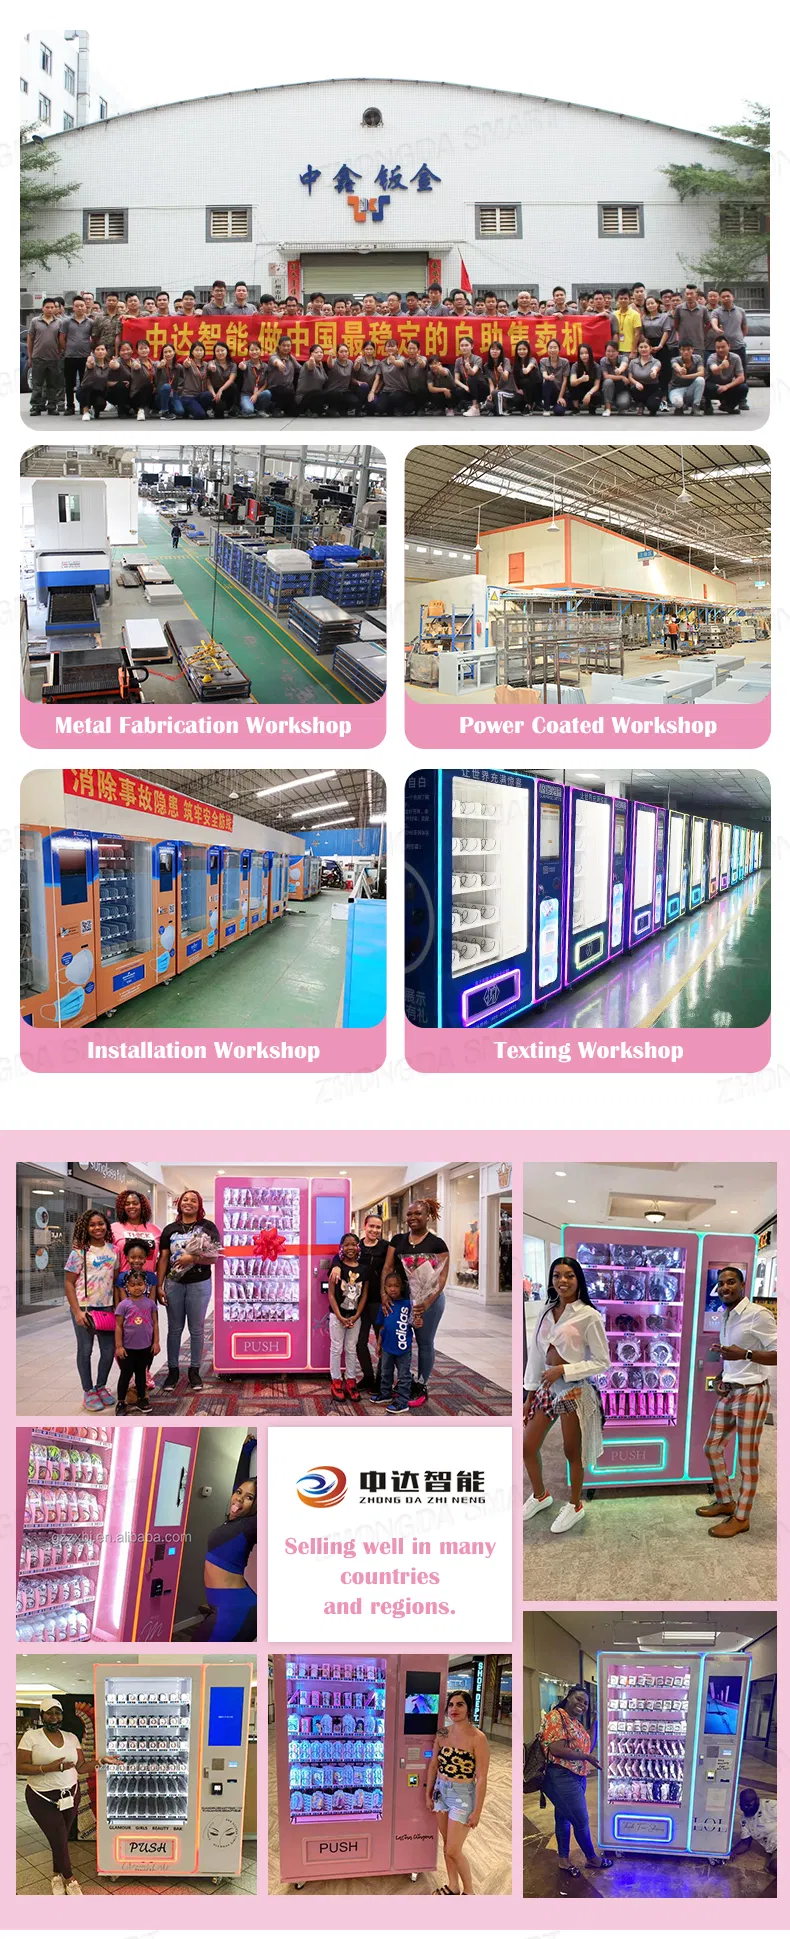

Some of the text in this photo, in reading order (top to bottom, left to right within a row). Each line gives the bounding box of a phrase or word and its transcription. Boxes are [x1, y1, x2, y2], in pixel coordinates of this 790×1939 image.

[299, 163, 441, 196] 中鑫钣金
[145, 321, 249, 358] 中达智能
[71, 769, 180, 819] 消除事故隐患
[396, 1306, 409, 1350] adidas
[244, 1341, 279, 1352] PUSH
[611, 1450, 646, 1461] PUSH
[360, 1471, 485, 1493] 中达智能
[476, 1661, 484, 1691] SHOE
[129, 1842, 167, 1853] PUSH
[319, 1841, 358, 1853] PUSH
